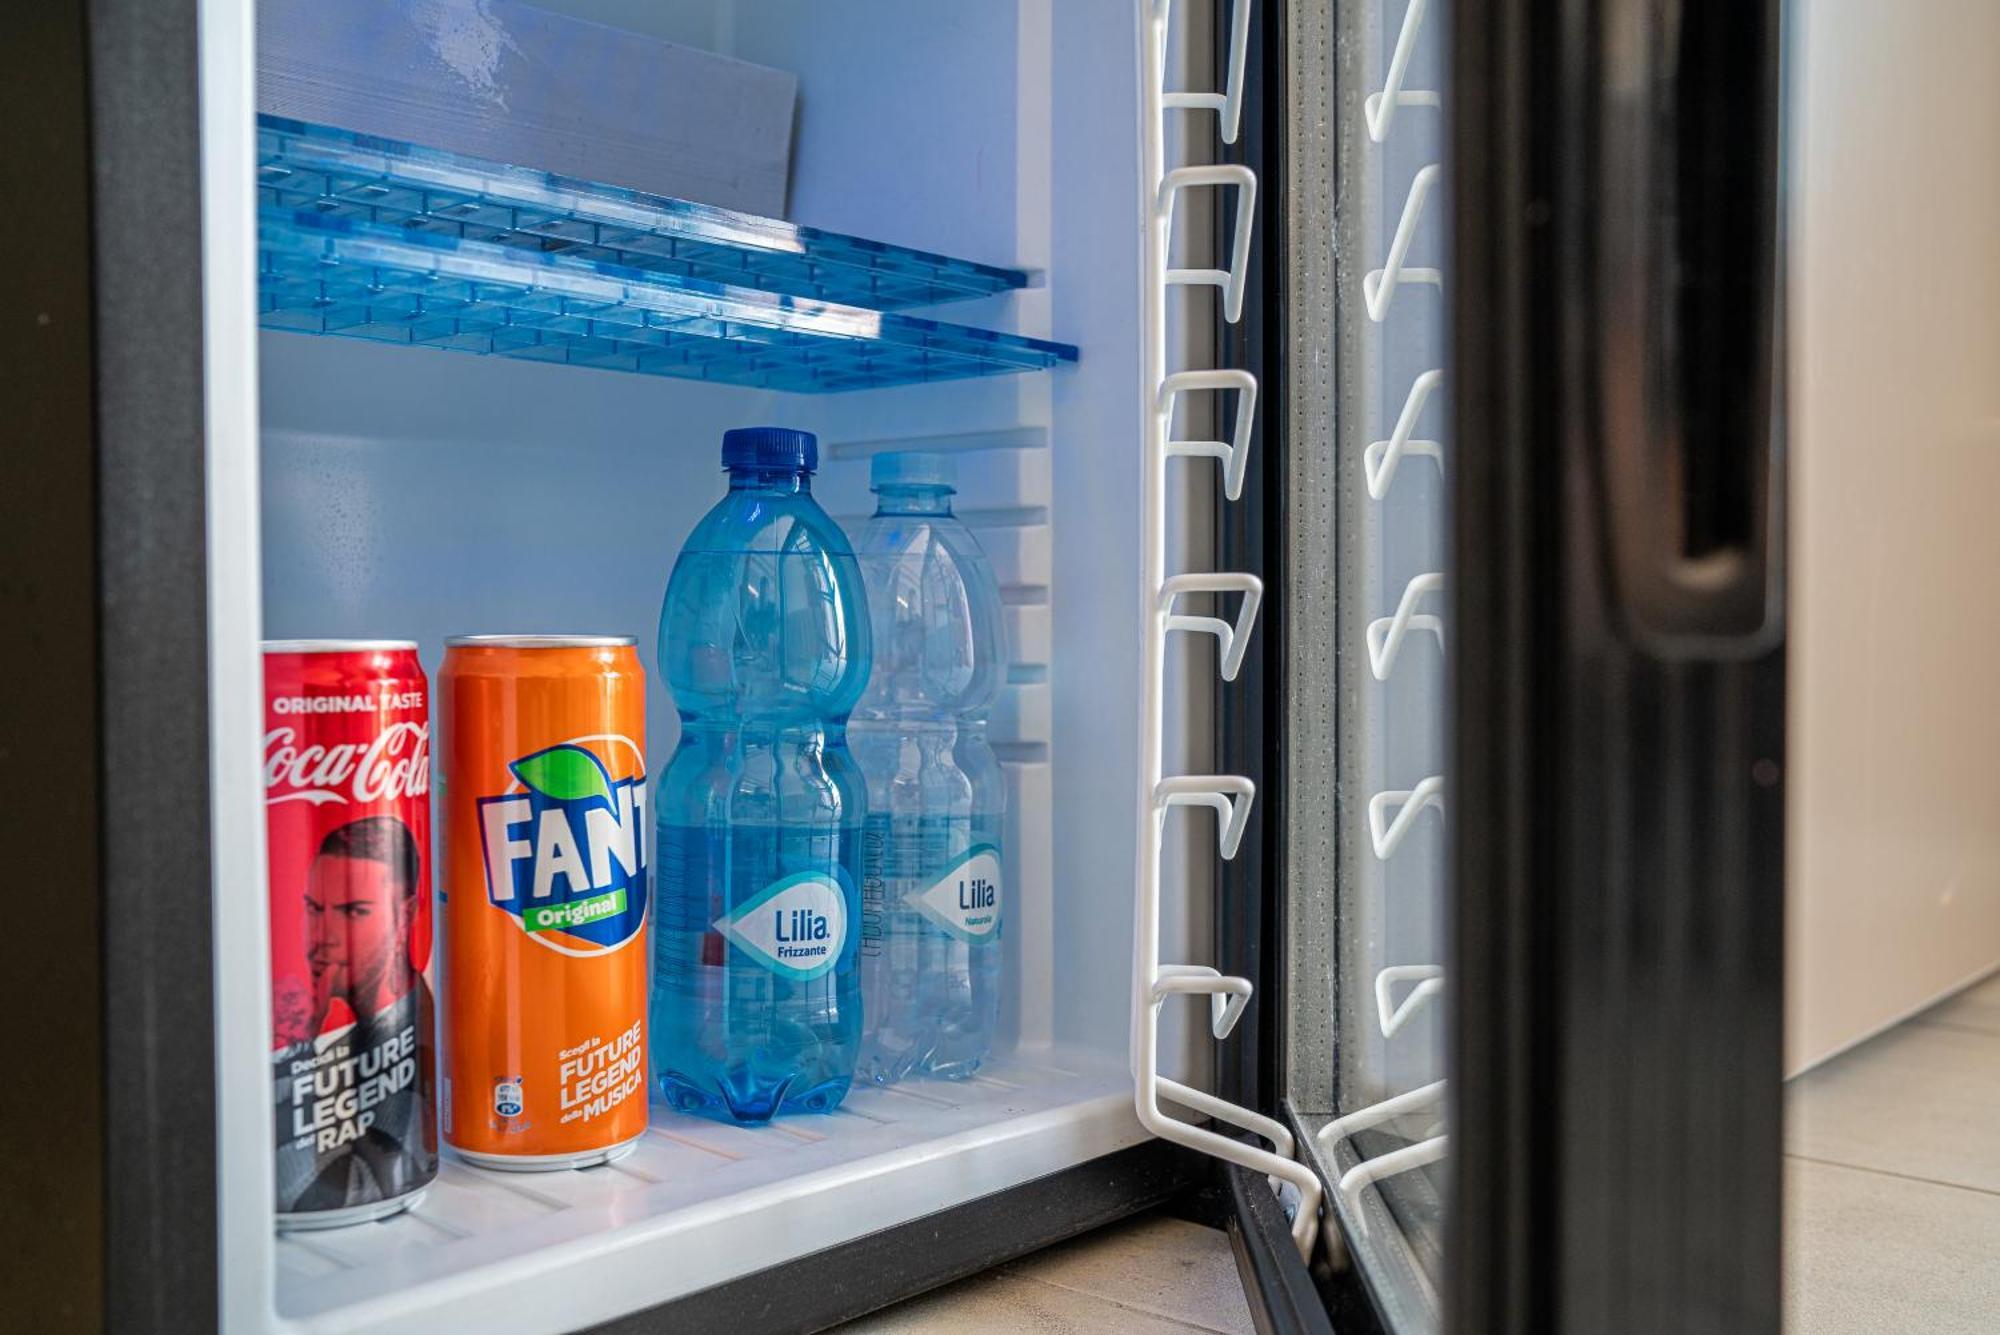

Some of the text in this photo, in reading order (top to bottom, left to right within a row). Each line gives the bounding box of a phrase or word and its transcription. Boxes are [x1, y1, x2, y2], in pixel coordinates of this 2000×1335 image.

[273, 692, 423, 714] ORIGINAL TASTE
[537, 895, 617, 926] Original
[960, 880, 995, 910] Lilia
[778, 946, 827, 958] Frizzante
[292, 1026, 415, 1106] FUTURE
[560, 1019, 641, 1085] FUTURE
[293, 1058, 416, 1137] LEGEND
[560, 1045, 641, 1110] LEGEND
[583, 1069, 642, 1122] MUSICA
[317, 1111, 375, 1153] RAP
